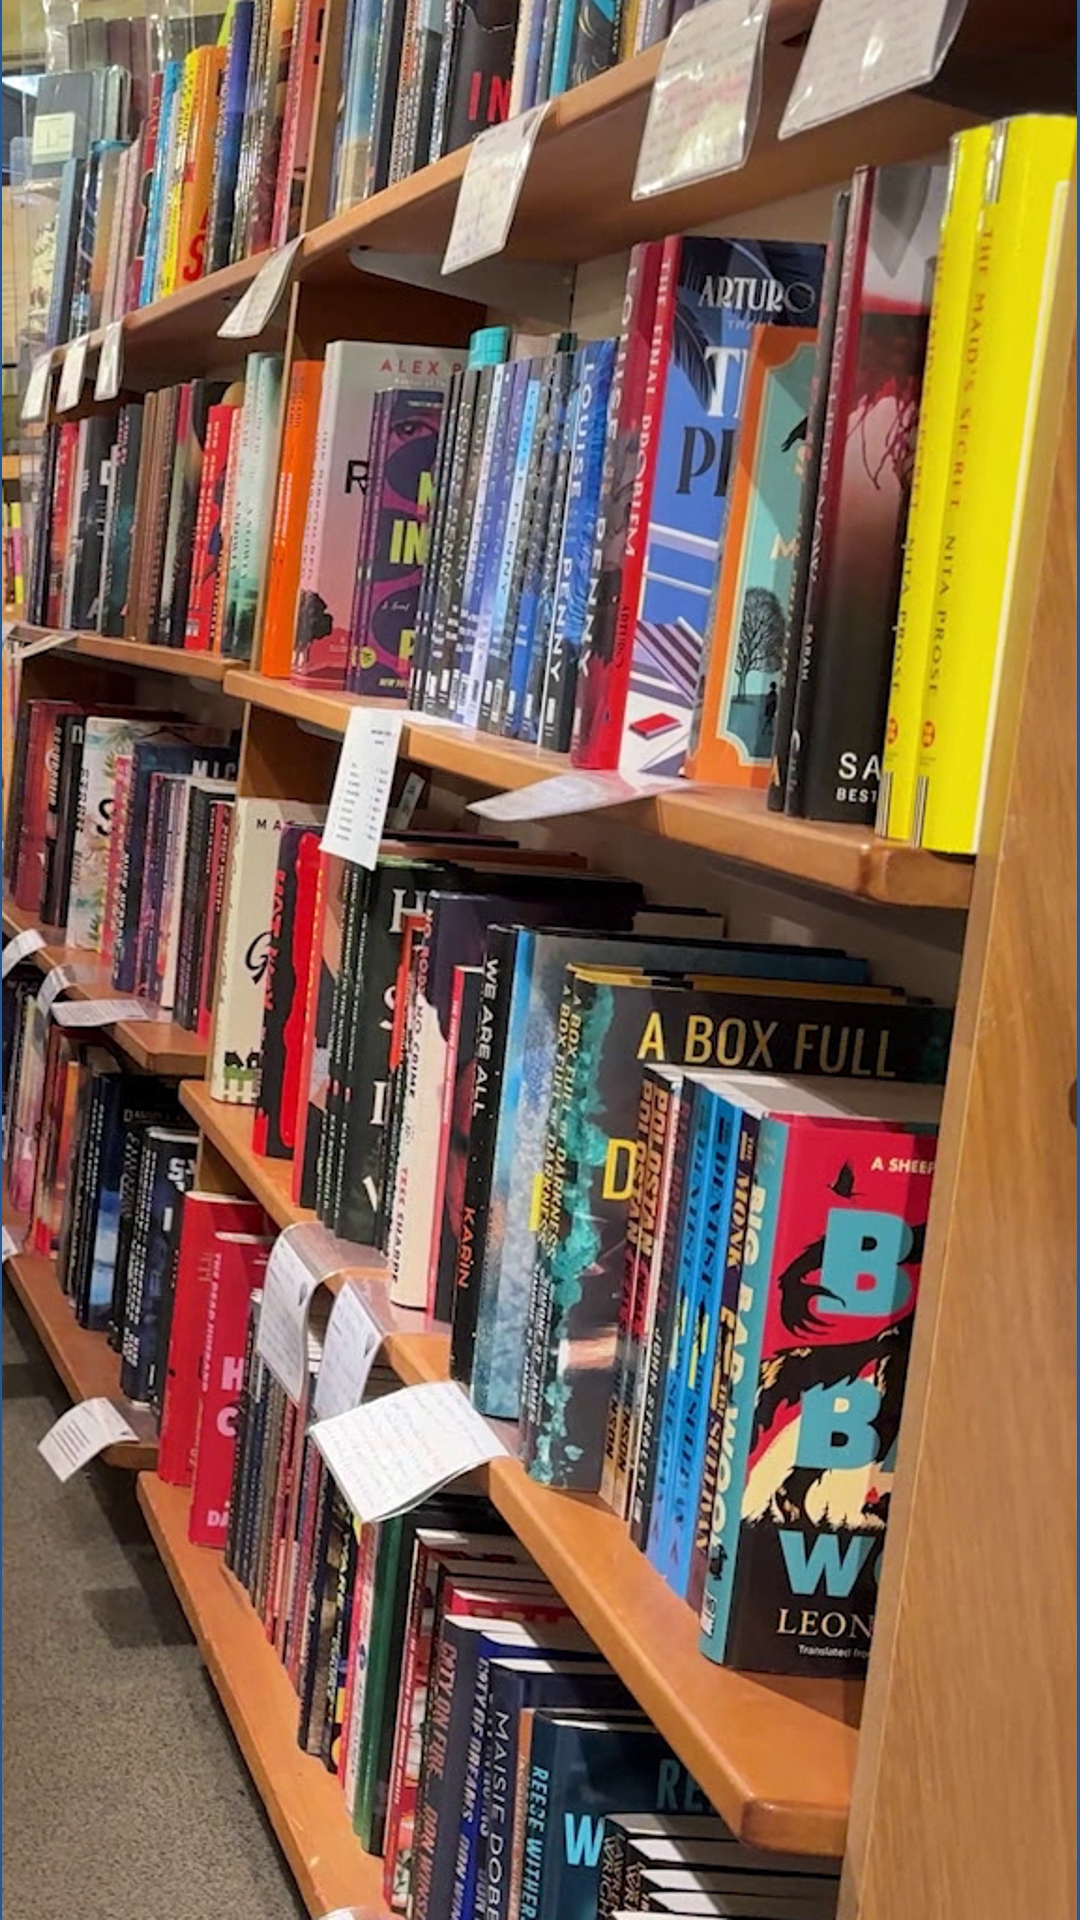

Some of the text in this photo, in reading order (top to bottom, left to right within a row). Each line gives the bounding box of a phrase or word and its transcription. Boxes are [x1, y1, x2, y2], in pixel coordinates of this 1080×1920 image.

[698, 275, 816, 313] ARTURO
[381, 360, 440, 376] ALEX
[950, 231, 992, 506] THE MAID'S SECRET
[625, 257, 671, 557] THE FINAL PROBLEM
[580, 267, 636, 677] LOUISE PENNY
[455, 499, 474, 588] PENNY
[500, 501, 519, 595] PENNY
[550, 362, 594, 682] LOUISE PENNY
[928, 536, 957, 691] NITA PROSE
[800, 624, 814, 681] SARAH
[423, 909, 434, 942] NO
[557, 1003, 571, 1046] BOX
[562, 985, 572, 996] A
[573, 995, 582, 1006] A
[406, 1039, 420, 1099] CRIME
[472, 959, 499, 1117] WE ARE ALL
[566, 1013, 582, 1059] BOX
[636, 1011, 896, 1078] A BOX FULL
[552, 1054, 566, 1100] FULL
[562, 1065, 577, 1114] FULL
[640, 1085, 670, 1258] POLOSTAN
[870, 1157, 884, 1171] A
[391, 1167, 409, 1284] TESS SHARPE
[547, 1149, 567, 1257] DARKNESS
[701, 1151, 728, 1290] DENTIST
[727, 1171, 751, 1270] MONK
[457, 1205, 476, 1289] KARIN
[201, 1252, 222, 1392] THE DEAD HUSBAND
[731, 1185, 766, 1385] BIG BAD
[637, 1326, 663, 1493] JOHN STRALEY
[695, 1419, 721, 1555] SULLIVAN
[437, 1641, 458, 1697] CITY
[799, 1644, 852, 1658] Translated
[433, 1698, 451, 1728] ON
[461, 1658, 489, 1824] CITY OF DREAMS
[427, 1730, 447, 1780] FIRE
[491, 1710, 510, 1824] MAISIE
[421, 1803, 440, 1851] DON
[527, 1766, 550, 1832] REESE
[455, 1833, 471, 1880] DON
